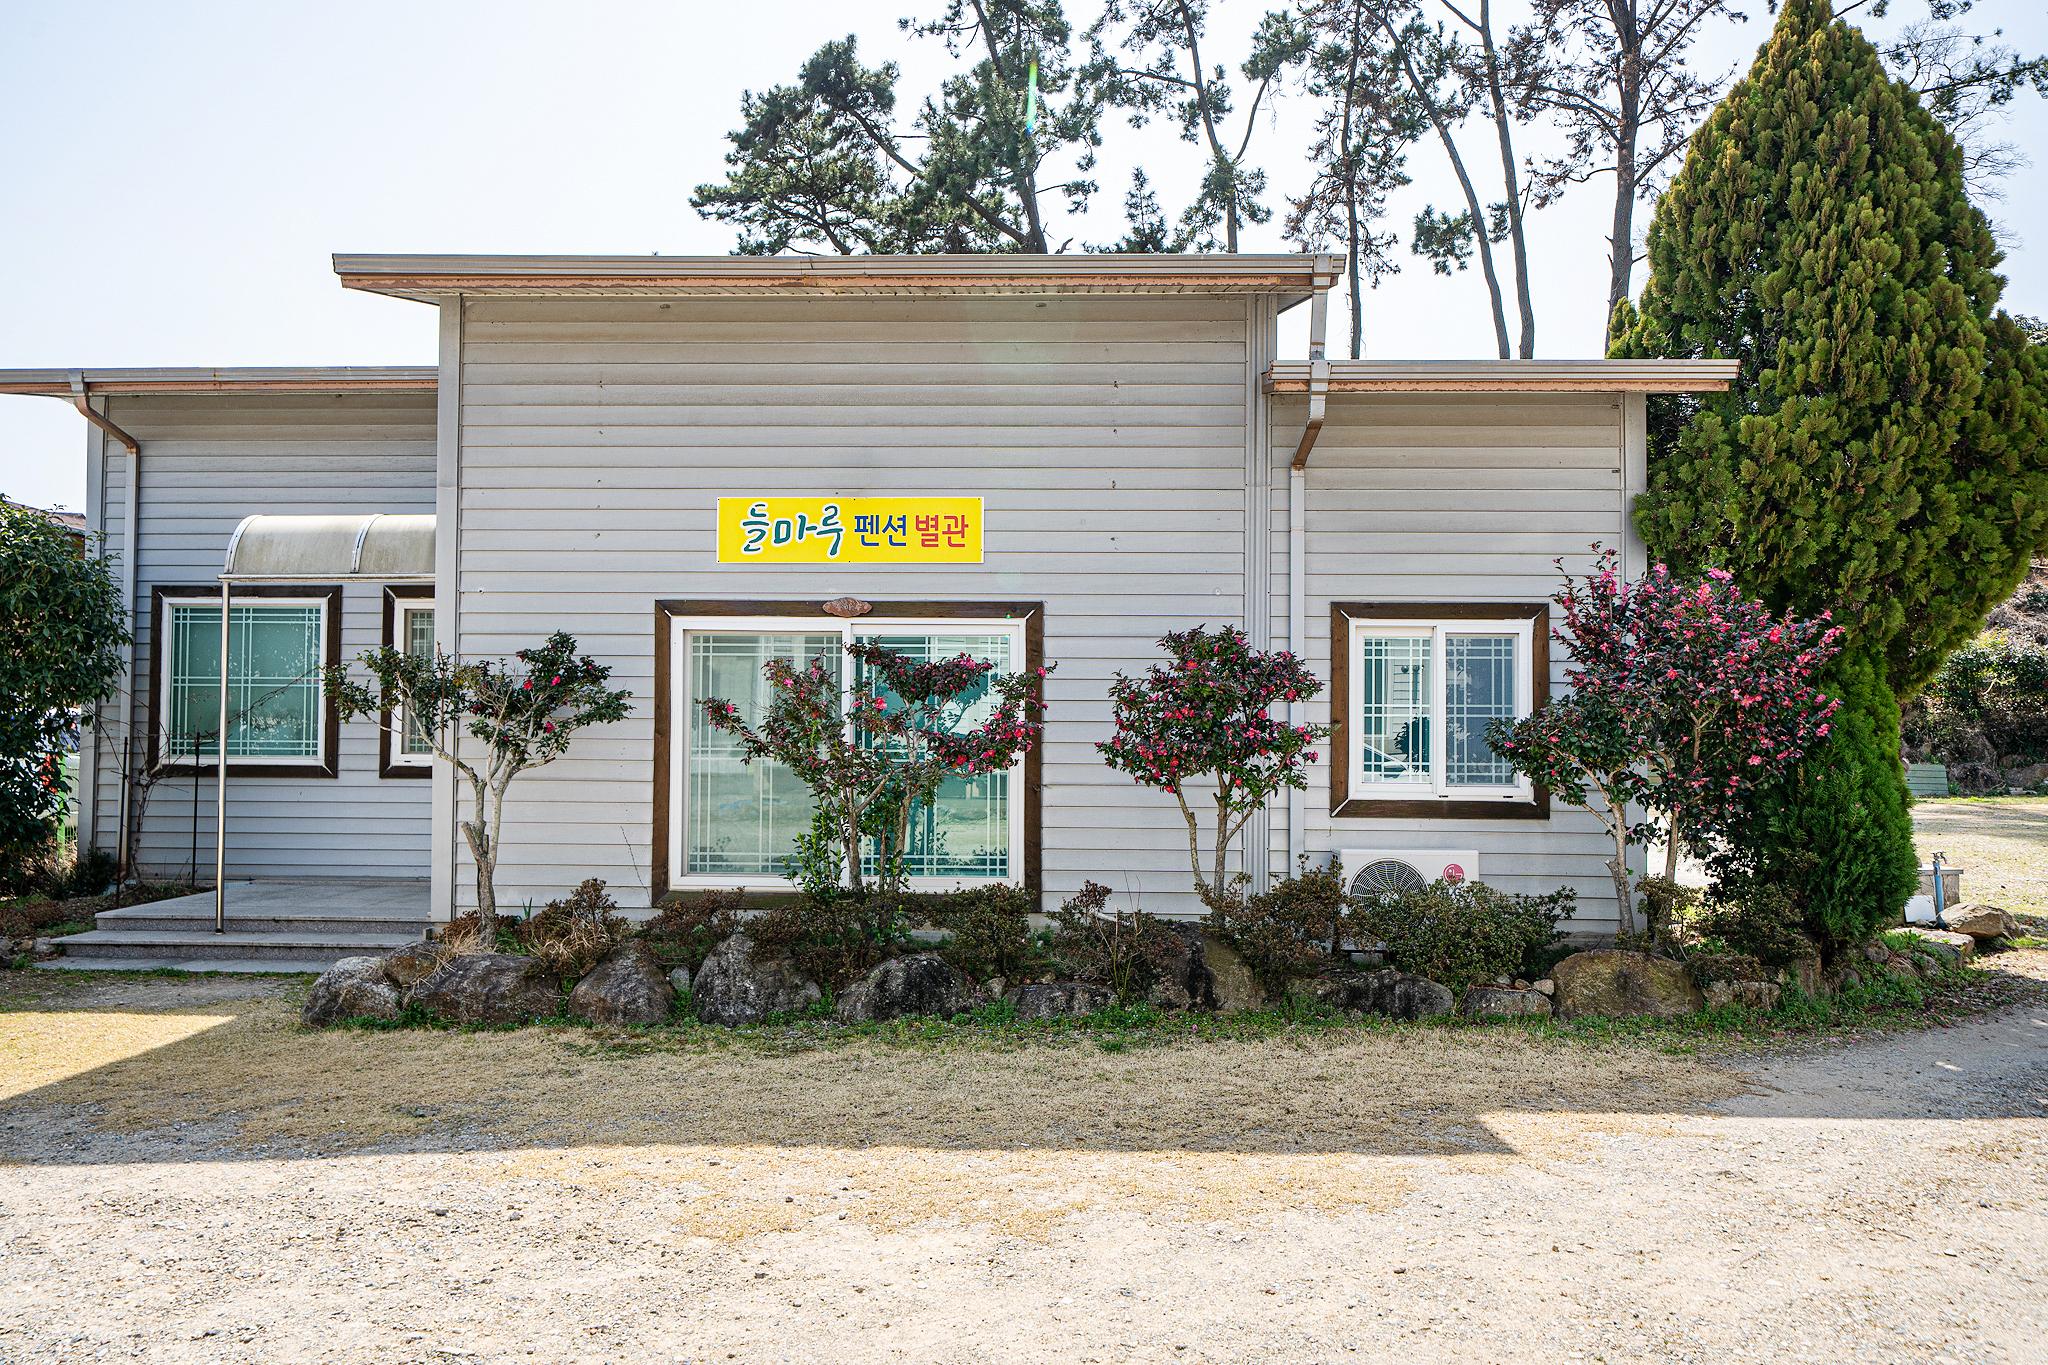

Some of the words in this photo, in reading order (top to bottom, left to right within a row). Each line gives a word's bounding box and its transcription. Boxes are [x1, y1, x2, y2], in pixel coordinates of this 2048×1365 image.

[742, 503, 844, 556] 들마루
[854, 514, 907, 547] 펜션
[915, 514, 969, 548] 별관
